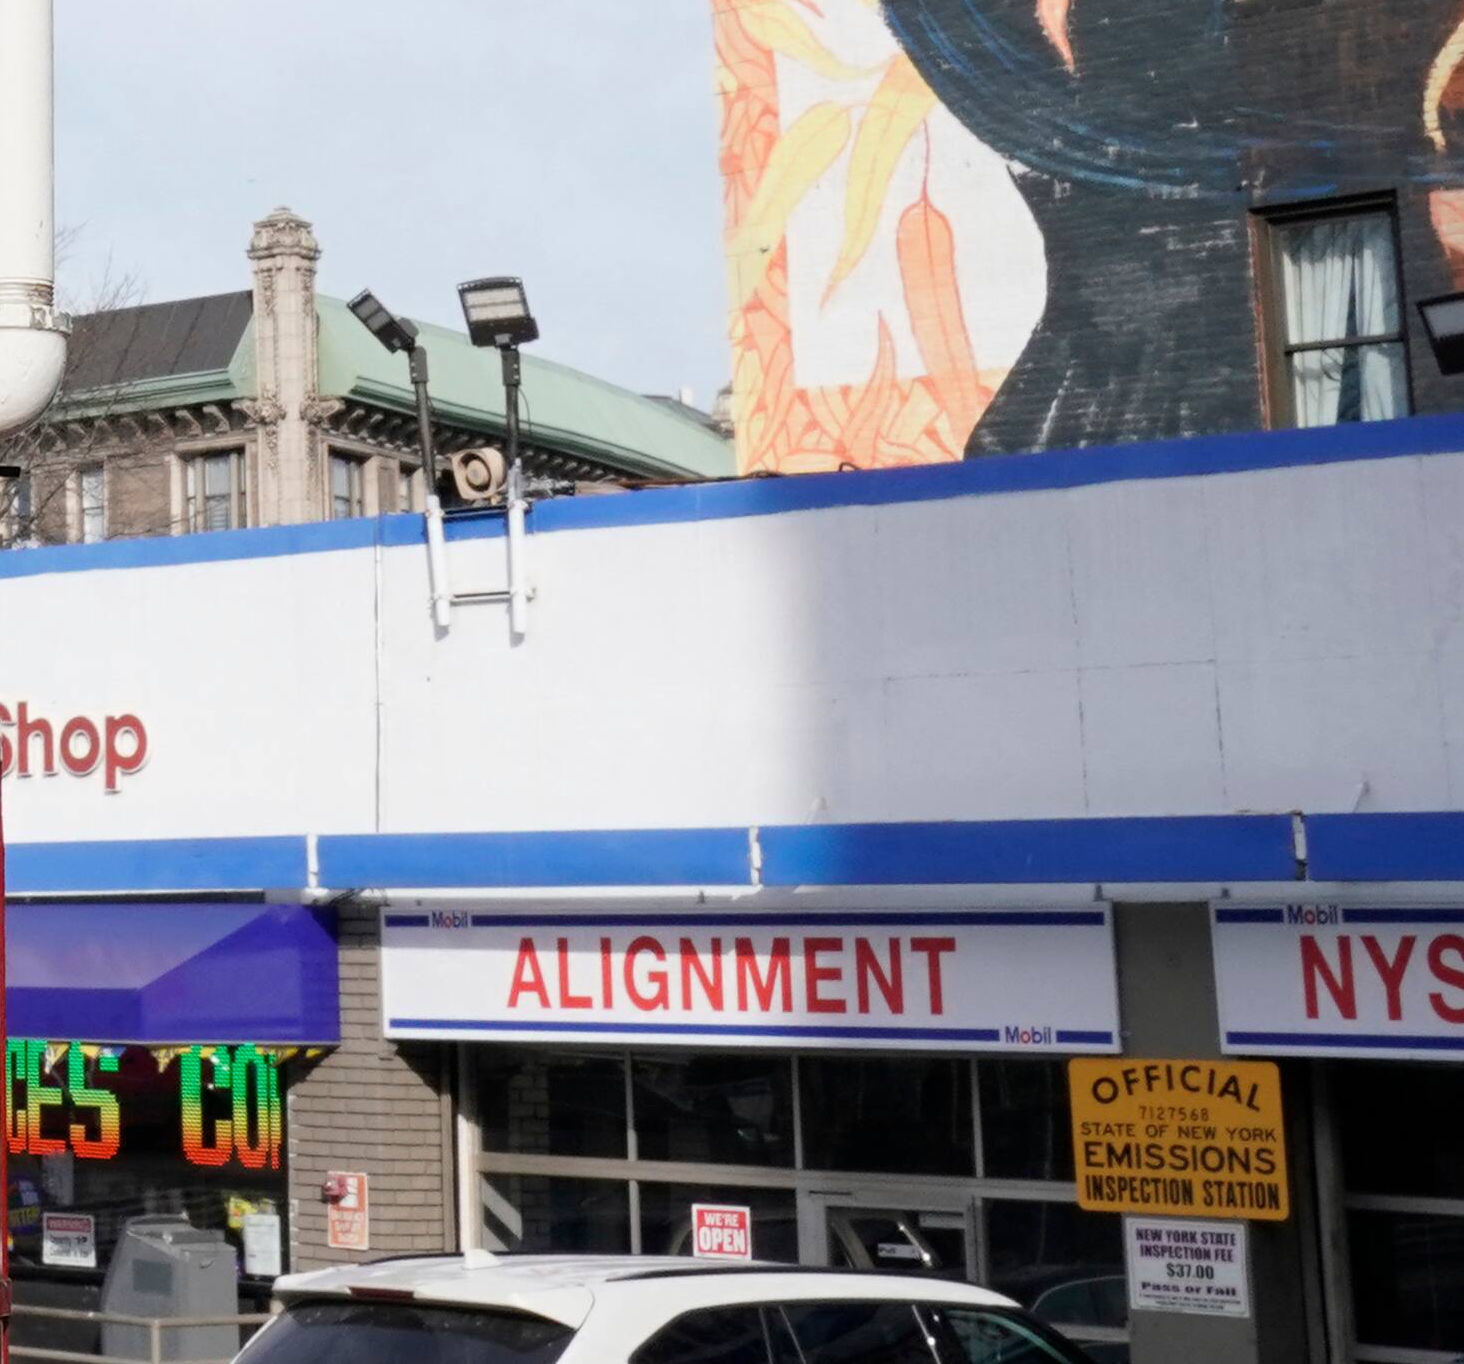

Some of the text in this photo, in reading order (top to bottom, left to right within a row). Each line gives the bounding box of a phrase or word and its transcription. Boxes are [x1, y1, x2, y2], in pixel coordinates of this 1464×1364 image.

[431, 909, 469, 928] Mobil
[1286, 904, 1339, 925] Mobil
[506, 936, 957, 1016] ALIGNMENT
[1300, 934, 1464, 1024] NYS
[1005, 1025, 1052, 1044] Mobil
[1091, 1064, 1260, 1112] OFFICIAL
[1081, 1122, 1277, 1142] STATE OF NEW YORK
[1084, 1141, 1276, 1175] EMISSIONS
[1085, 1175, 1280, 1210] INSPECTION STATION
[700, 1226, 745, 1253] OPEN
[1136, 1228, 1236, 1246] NEW YORK STATE
[1140, 1244, 1234, 1263] INSPECTION FEE
[1166, 1262, 1215, 1280] $37.00
